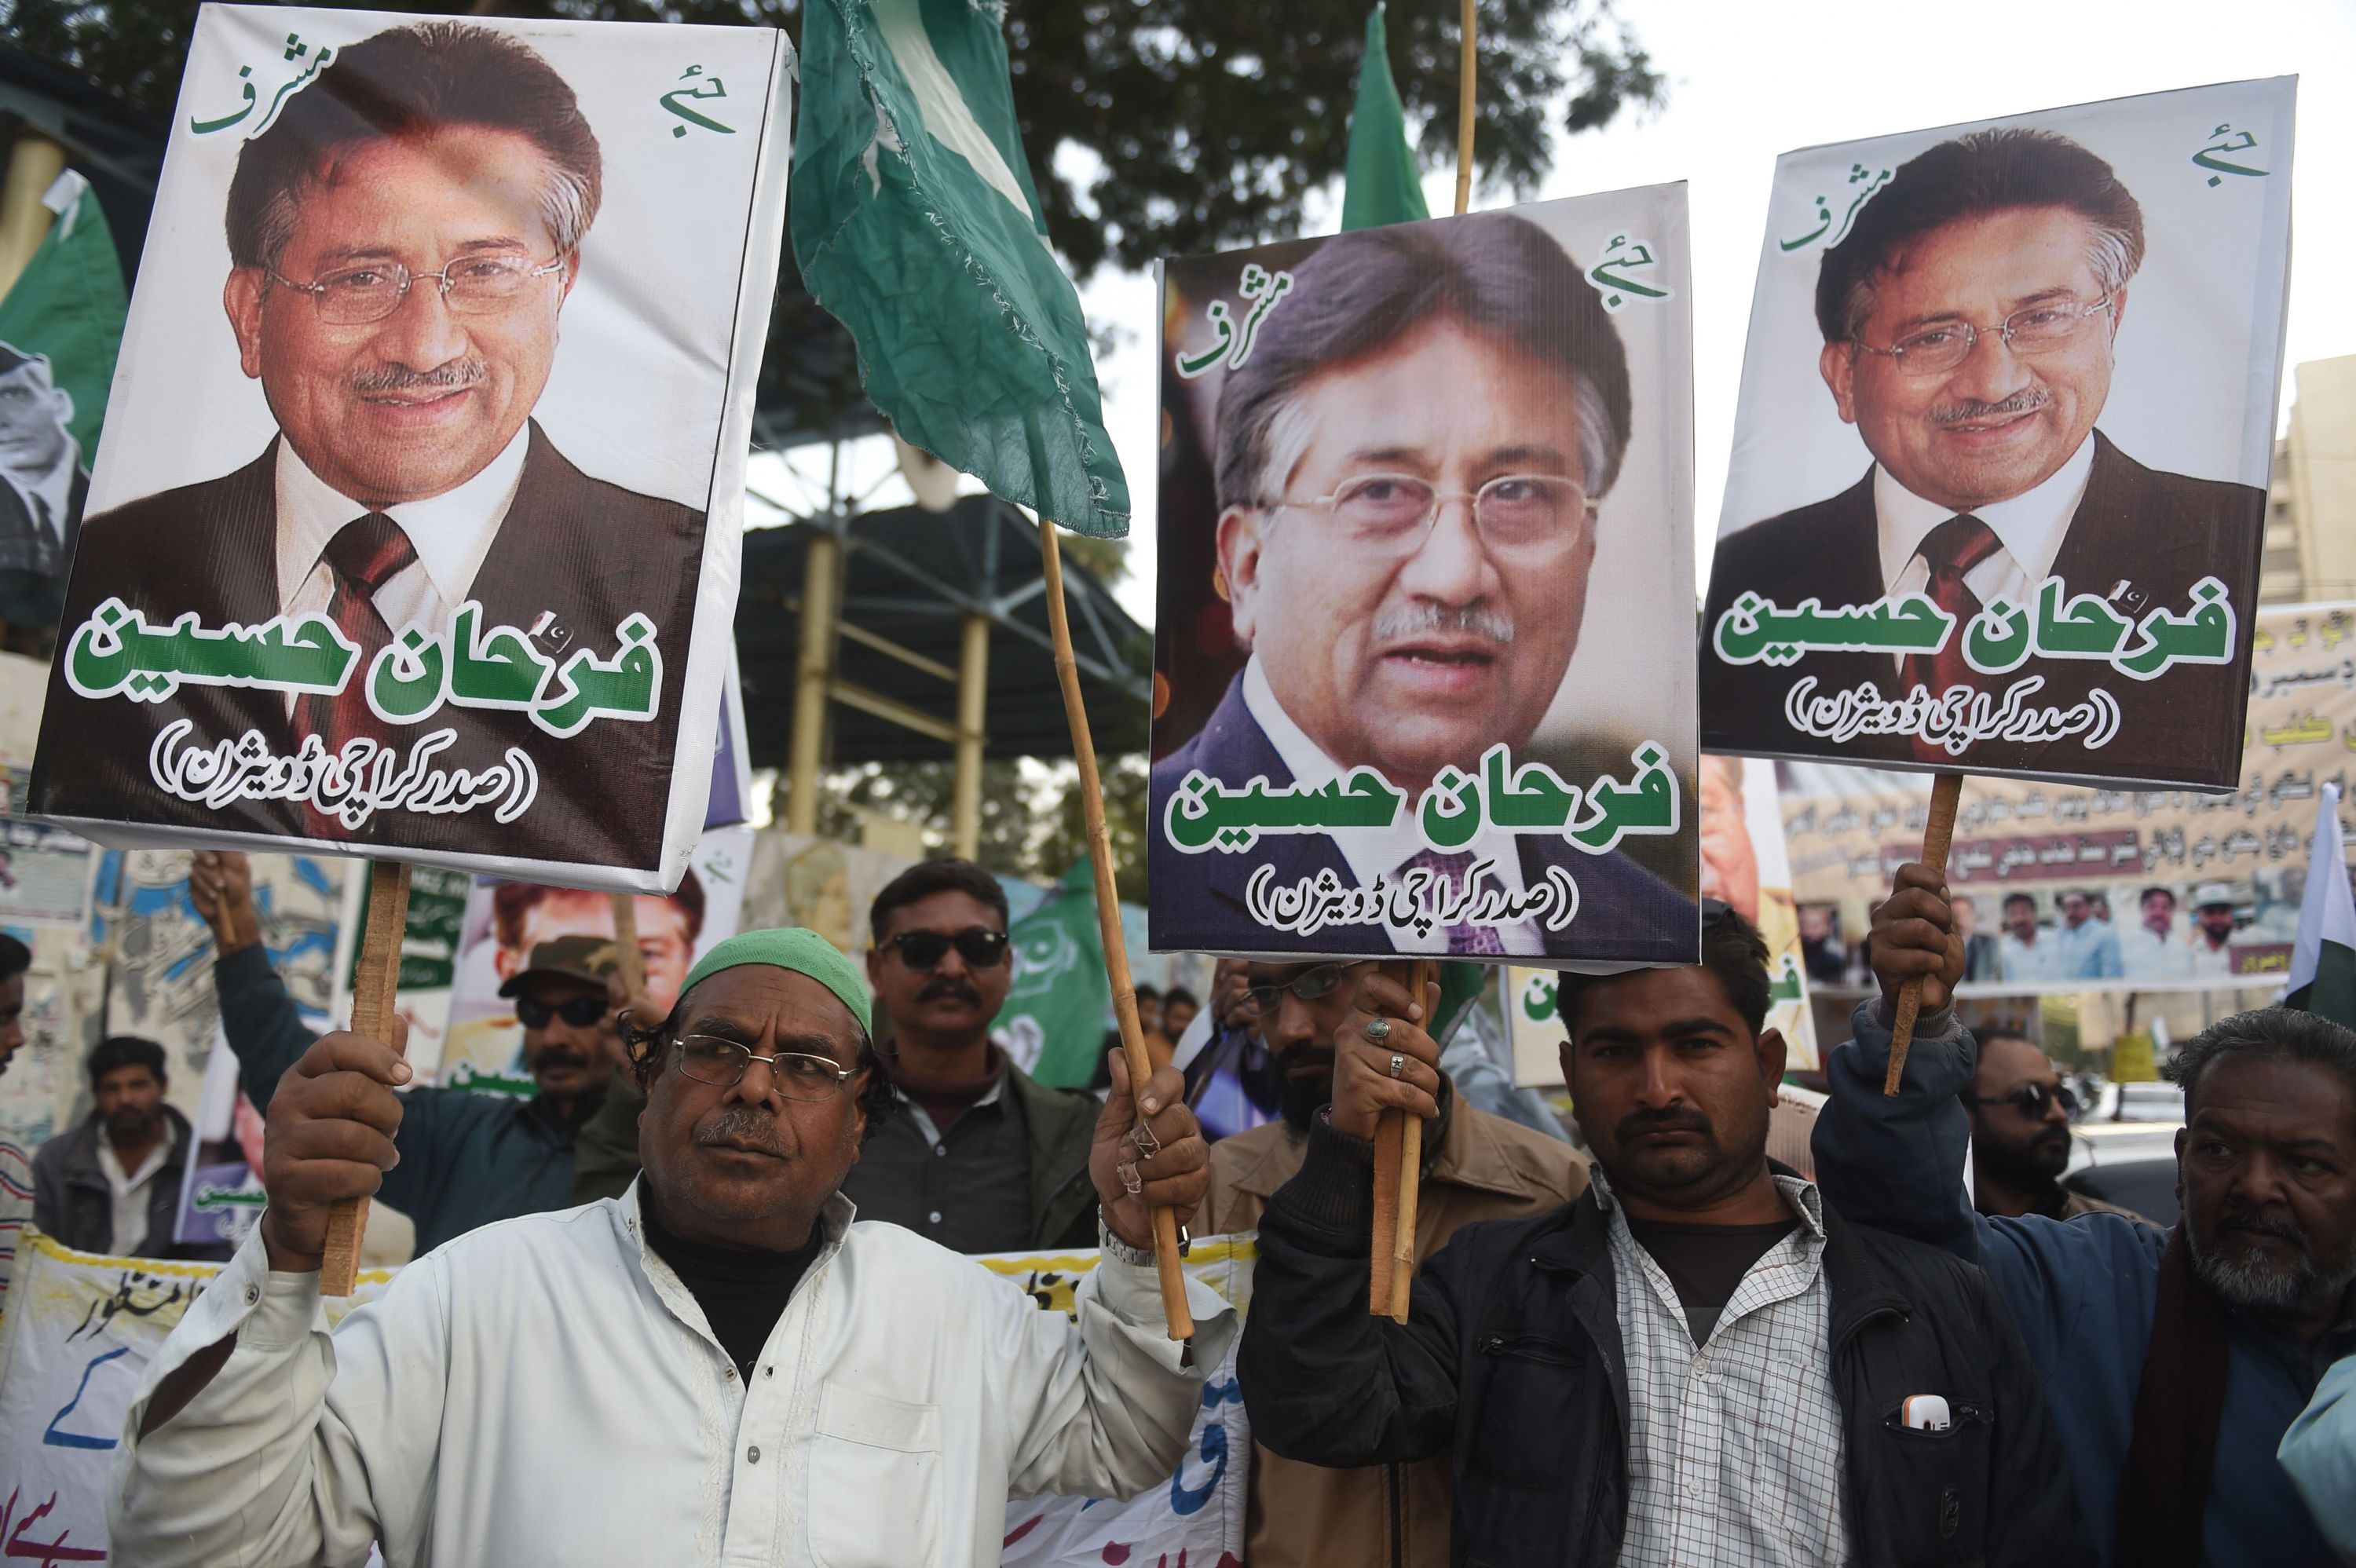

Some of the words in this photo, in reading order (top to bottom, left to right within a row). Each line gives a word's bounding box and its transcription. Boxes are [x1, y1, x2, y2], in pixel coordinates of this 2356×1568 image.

[189, 33, 335, 137] مشرف
[1779, 163, 1894, 253] مشرف
[1177, 263, 1293, 378] مشرف
[64, 597, 360, 702] حسین
[366, 600, 663, 738] فرحان
[1713, 590, 1956, 666] حسین
[1963, 576, 2236, 680] فرحان
[1920, 674, 2044, 755] کراچی
[313, 727, 457, 830] کراچی
[1164, 765, 1407, 853] حسین
[1416, 739, 1681, 854] فرحان
[1388, 857, 1500, 939] کراچی
